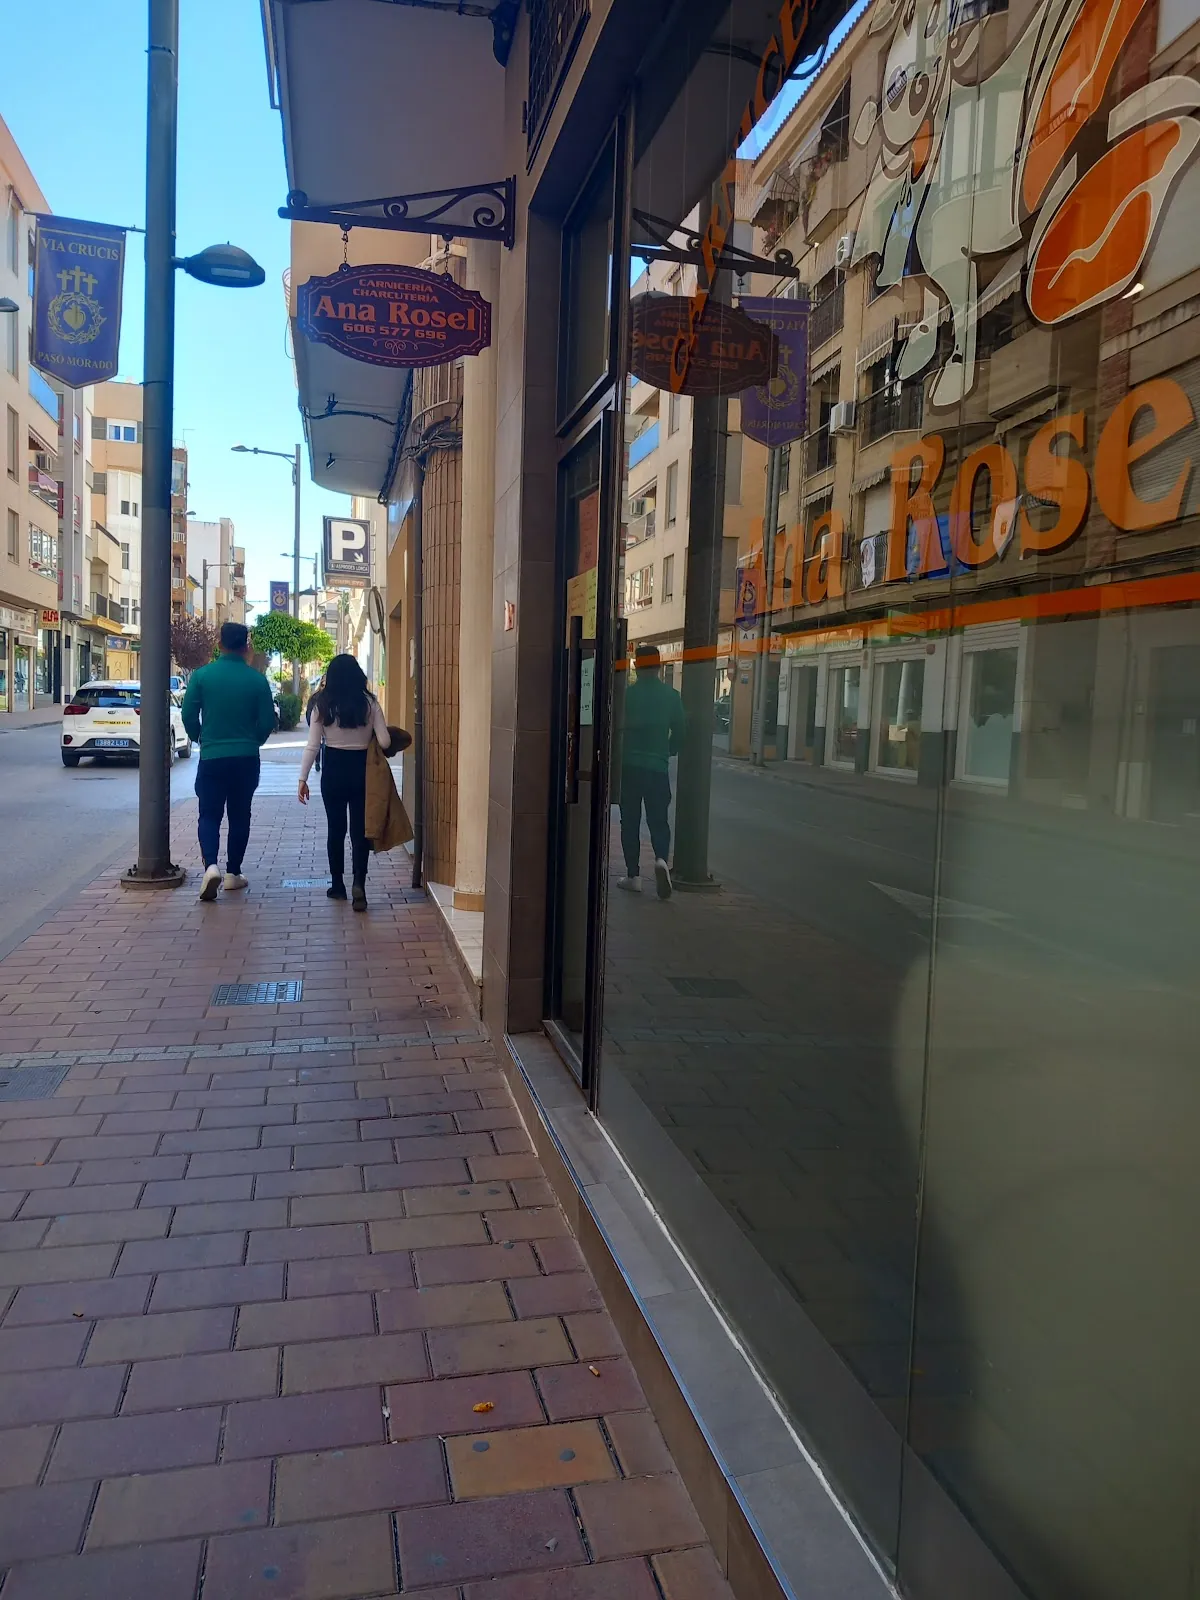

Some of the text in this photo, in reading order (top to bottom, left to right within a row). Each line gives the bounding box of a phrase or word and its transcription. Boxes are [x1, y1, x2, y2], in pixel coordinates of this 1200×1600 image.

[40, 237, 119, 260] VIA CRUCIS
[314, 296, 476, 331] Ana Rosel
[343, 323, 447, 340] 606 577 696
[38, 351, 112, 369] PASO MORADO
[331, 521, 366, 561] P
